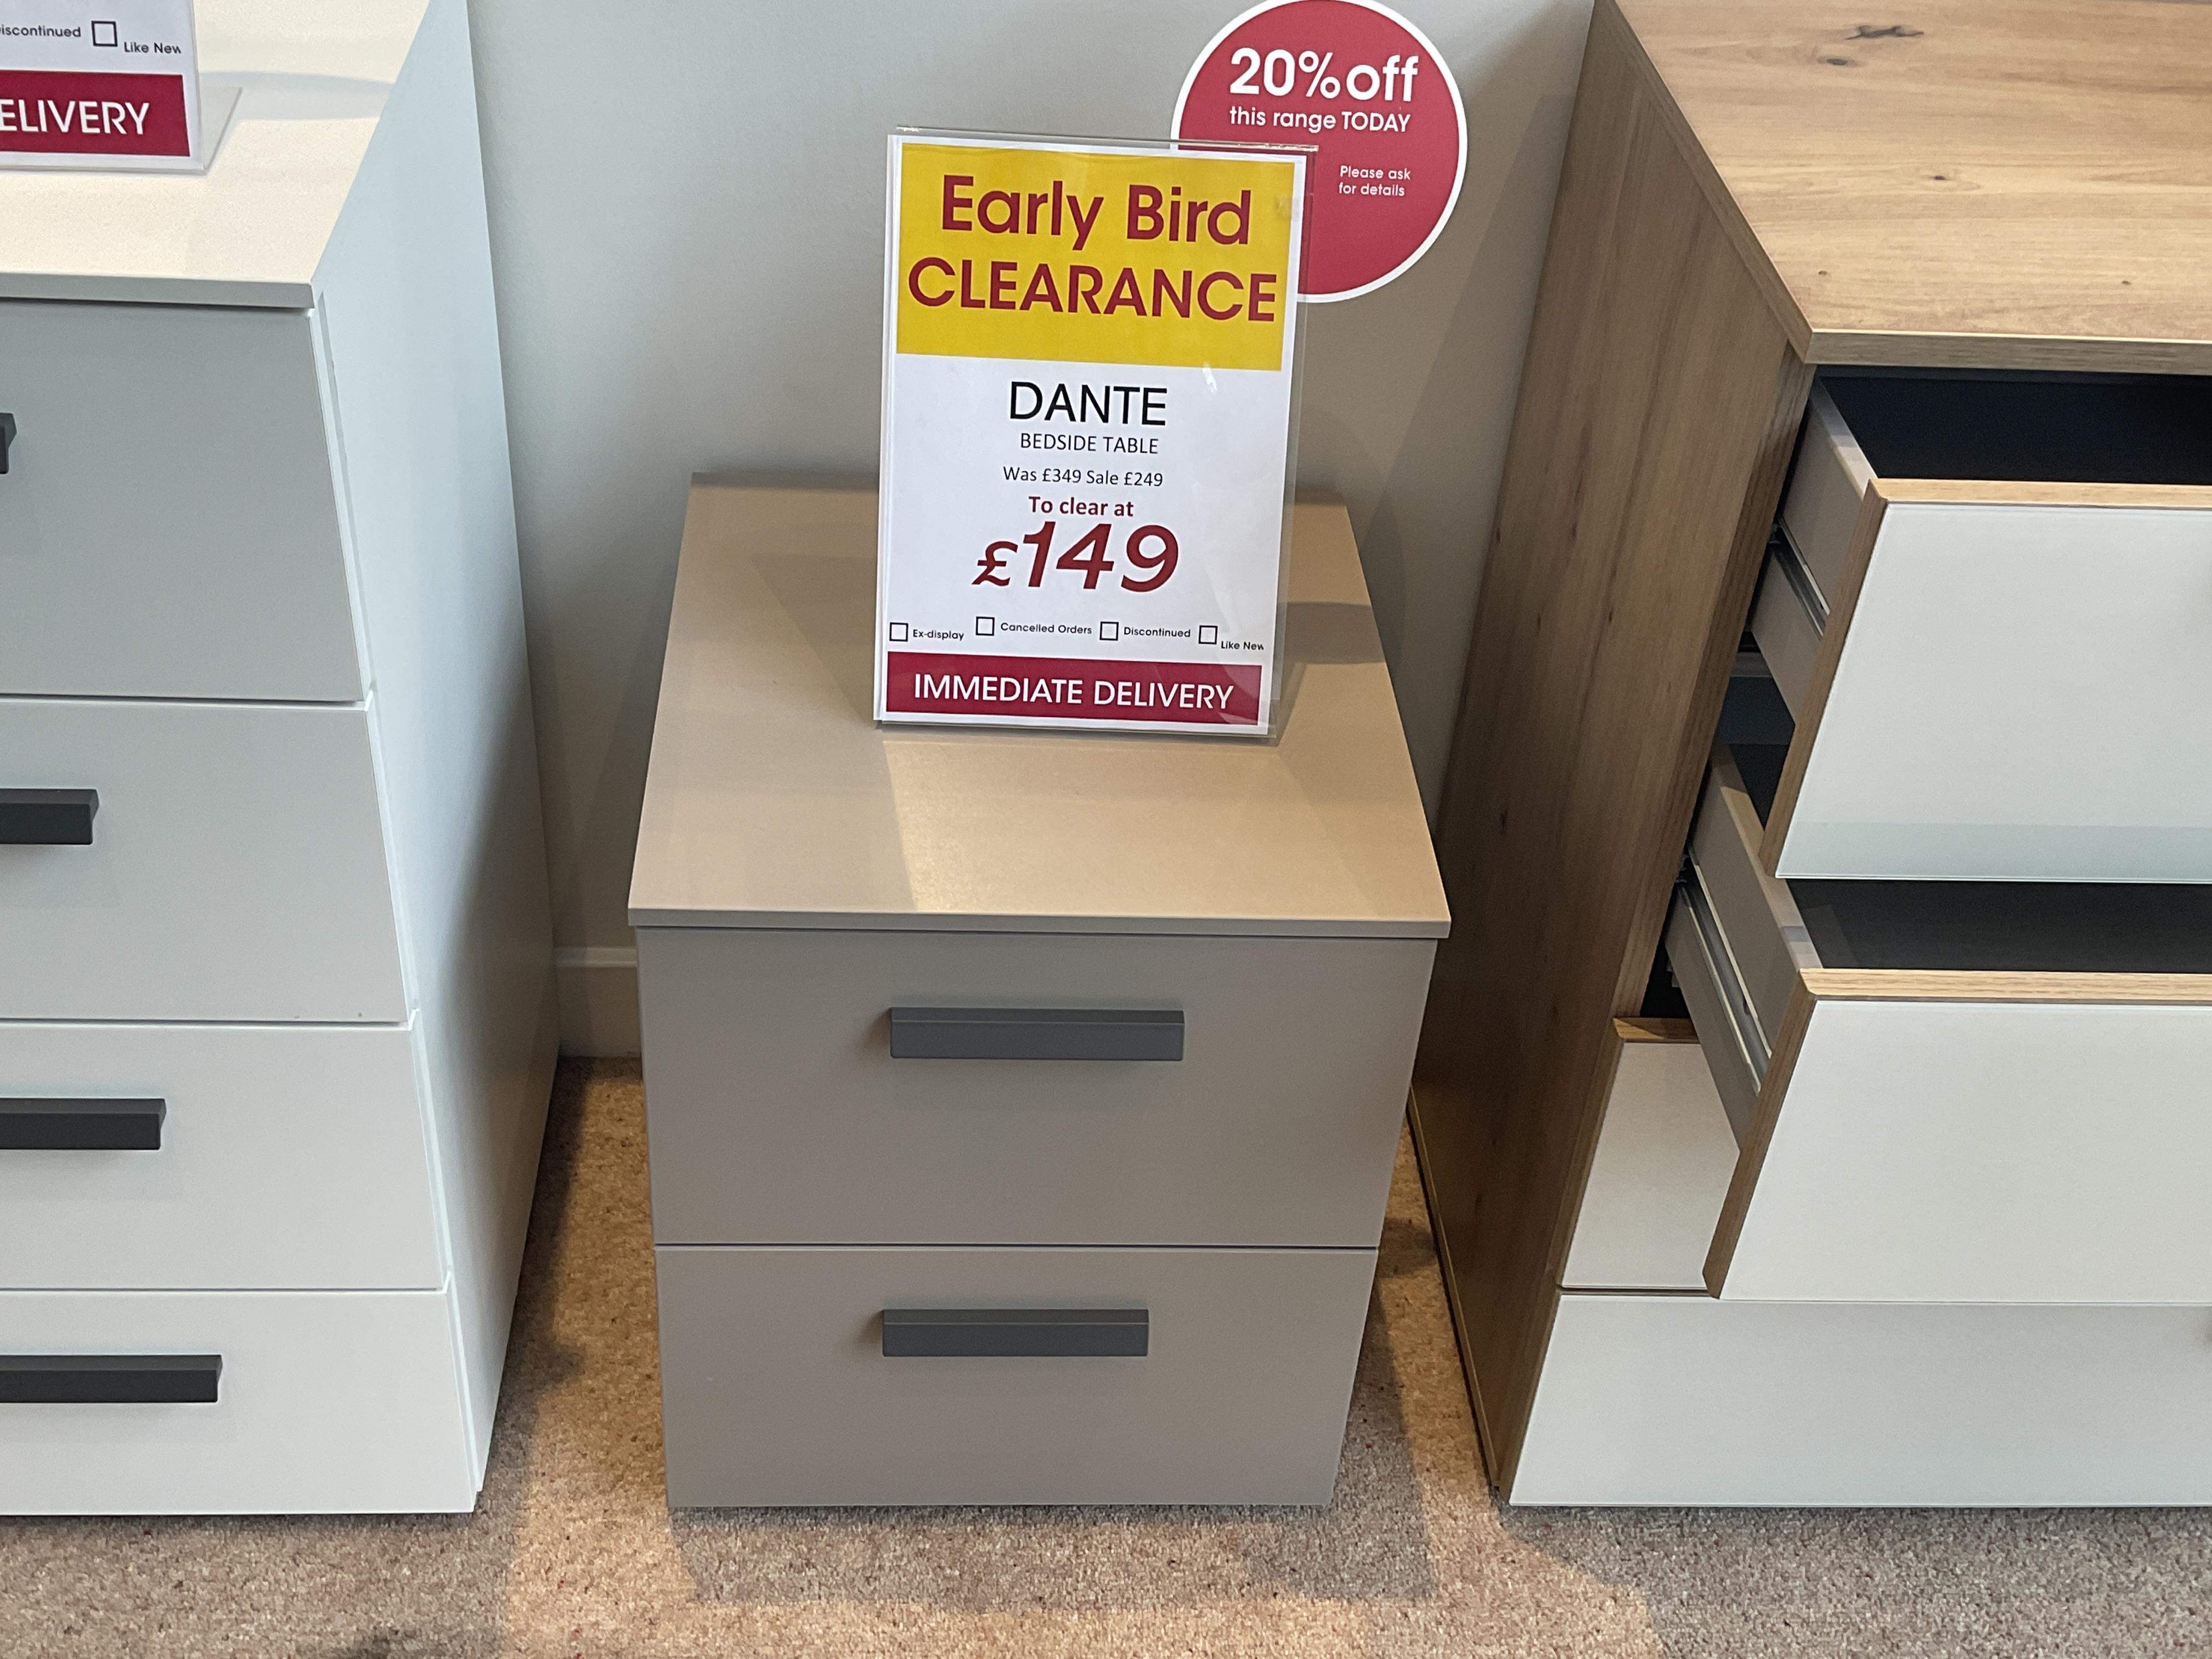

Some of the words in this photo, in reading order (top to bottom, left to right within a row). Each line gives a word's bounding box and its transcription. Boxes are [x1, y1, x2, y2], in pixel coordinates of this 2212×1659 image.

[0, 24, 81, 37] iscontinued
[124, 42, 149, 53] Like
[0, 99, 149, 135] ELIVERY
[1229, 106, 1266, 126] this
[1273, 111, 1336, 133] range
[1341, 111, 1411, 132] TODAY
[1340, 165, 1384, 179] Please
[1388, 168, 1411, 180] ask
[1339, 182, 1357, 194] for
[1361, 183, 1405, 196] details
[942, 174, 1104, 250] Early
[1126, 184, 1251, 245] Bird
[909, 257, 1277, 321] CLEARANCE
[1009, 381, 1167, 426] DANTE
[1020, 433, 1097, 452] BEDSIDE
[1103, 437, 1159, 454] TABLE
[1003, 466, 1036, 482] Was
[1042, 468, 1081, 483] £349
[1086, 470, 1119, 485] Sale
[1124, 472, 1163, 487] £249
[1029, 496, 1053, 514] To
[1059, 497, 1108, 515] clear
[1114, 501, 1134, 517] at
[971, 521, 1179, 592] £149
[912, 629, 964, 641] Ex-display
[1001, 623, 1054, 633] Cancelled
[1058, 625, 1092, 634] Orders
[1124, 627, 1190, 637] Discontinued
[1221, 641, 1240, 650] Like
[915, 674, 1083, 703] IMMEDIATE
[1093, 681, 1234, 709] DELIVERY
